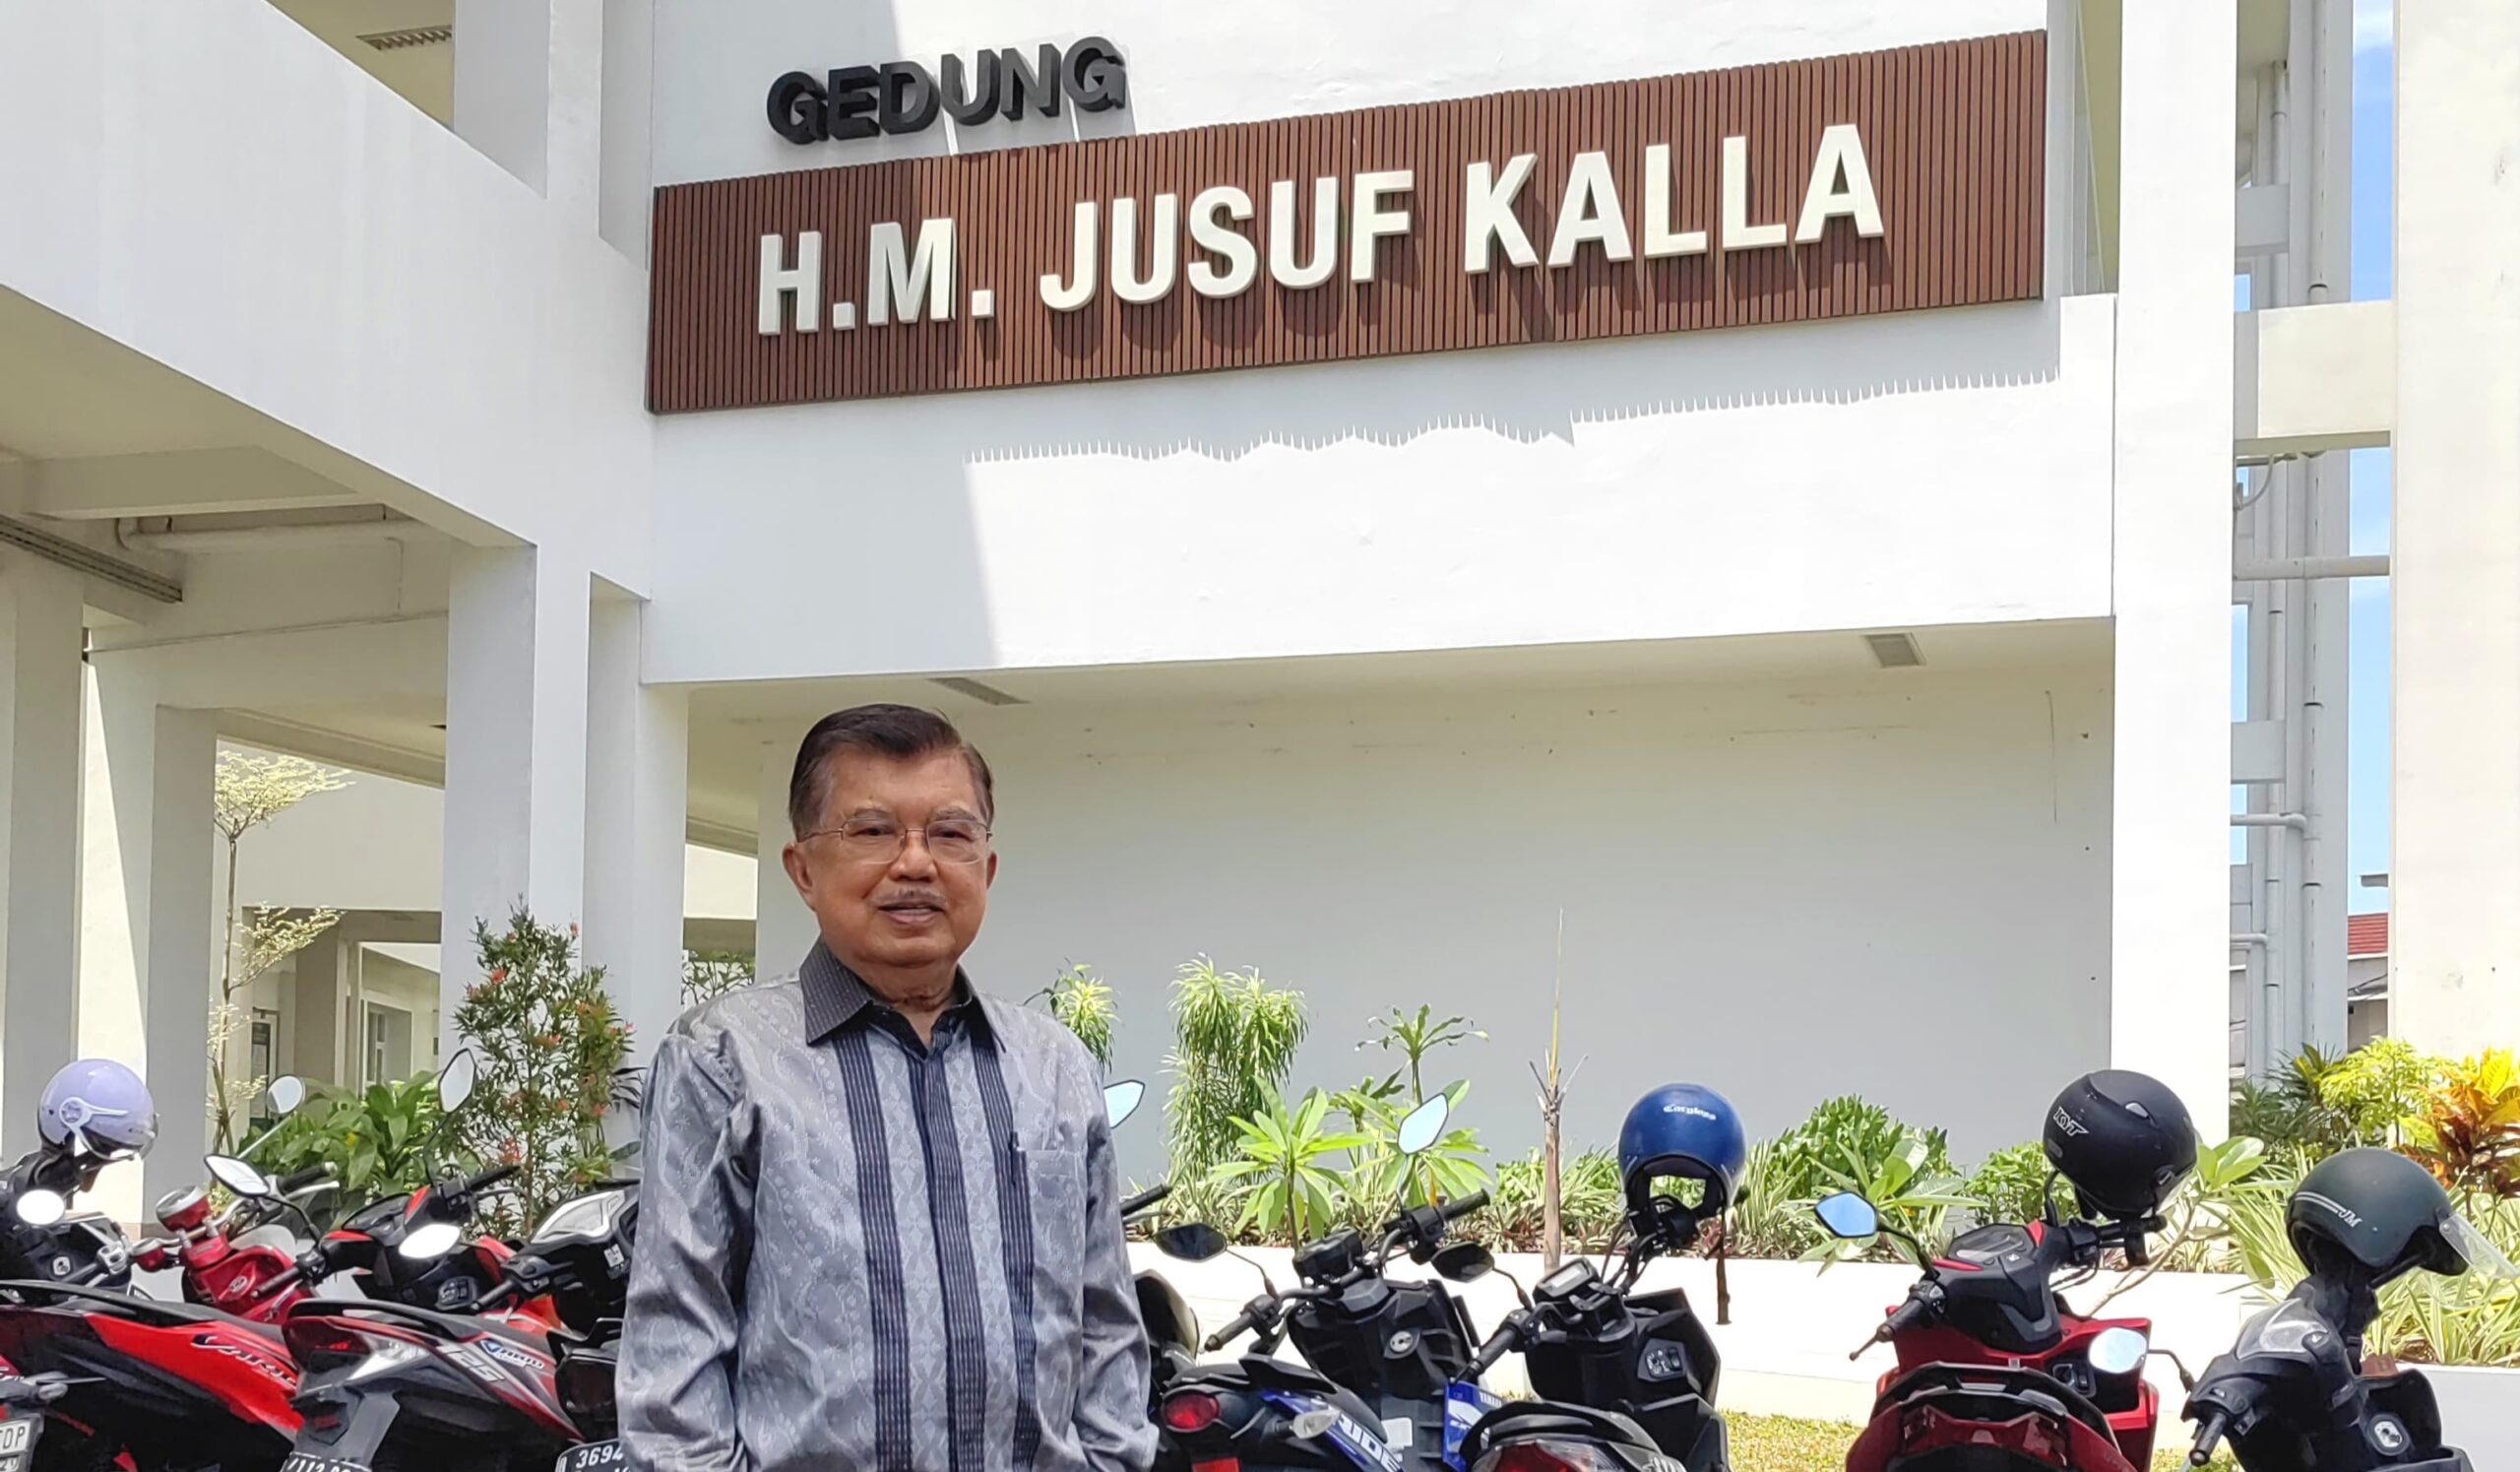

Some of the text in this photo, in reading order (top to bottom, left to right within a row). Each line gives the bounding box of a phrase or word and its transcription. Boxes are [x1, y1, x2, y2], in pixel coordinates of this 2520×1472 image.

[767, 35, 1126, 145] GEDUNG
[758, 123, 1884, 336] H.M. JUSUF KALLA
[2052, 1106, 2089, 1136] KYT
[435, 1344, 505, 1382] 125
[0, 1426, 26, 1449] DP
